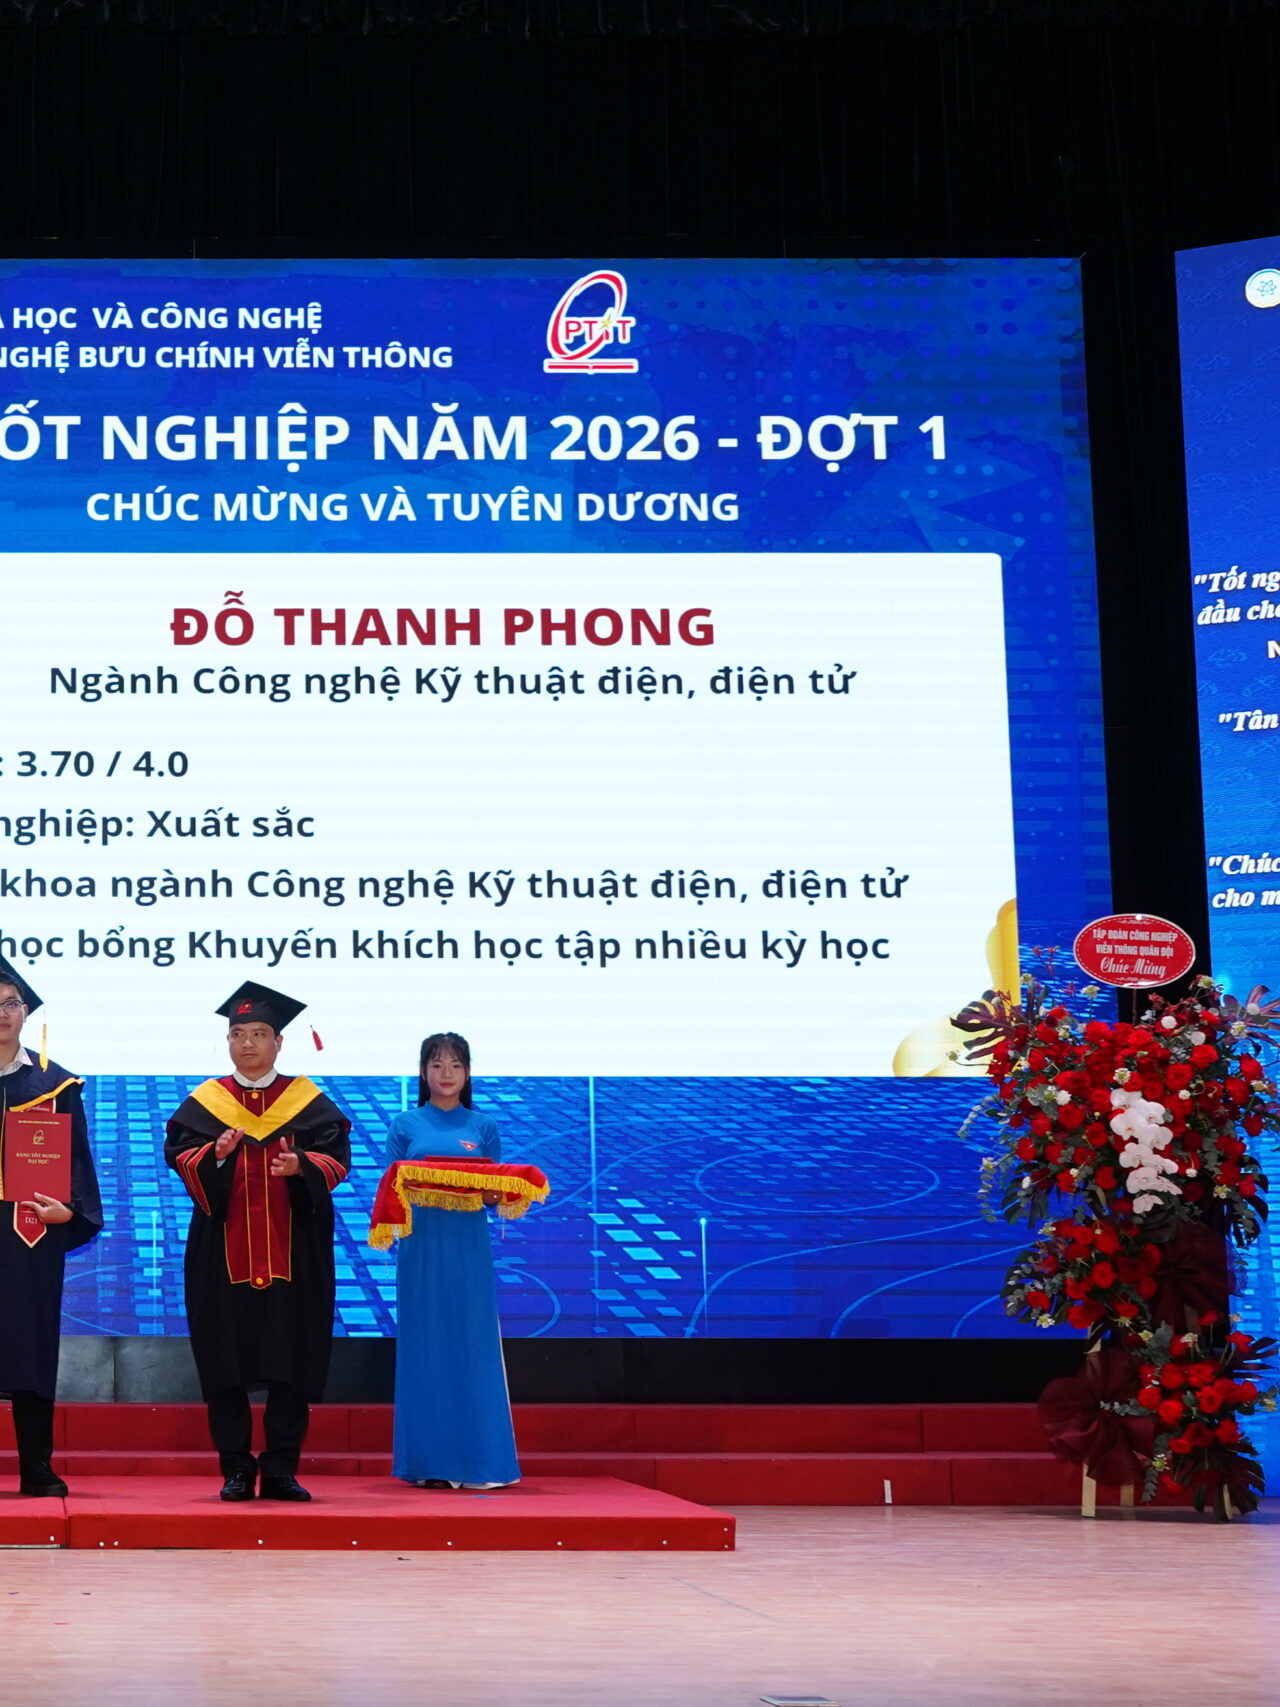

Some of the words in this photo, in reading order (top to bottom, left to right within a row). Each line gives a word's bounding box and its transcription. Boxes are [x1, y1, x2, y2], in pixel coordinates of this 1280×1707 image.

[13, 307, 77, 334] HỌC
[92, 301, 133, 329] VÀ
[141, 301, 228, 329] CÔNG
[238, 301, 322, 334] NGHỆ
[79, 345, 146, 368] BƯU
[155, 341, 254, 368] CHÍNH
[262, 337, 334, 368] VIỄN
[342, 341, 453, 368] THÔNG
[103, 402, 350, 473] NGHIỆP
[373, 402, 527, 461] NĂM
[550, 415, 700, 461] 2026
[718, 438, 738, 448] -
[756, 412, 899, 473] ĐỢT
[918, 415, 946, 460] 1
[86, 485, 200, 521] CHÚC
[214, 485, 348, 521] MỪNG
[360, 485, 417, 521] VÀ
[426, 485, 563, 521] TUYÊN
[578, 491, 739, 522] DƯƠNG
[1194, 565, 1247, 593] "Tốt
[169, 590, 255, 646] ĐỖ
[273, 608, 481, 646] THANH
[503, 607, 716, 647] PHONG
[1197, 598, 1241, 625] đầu
[50, 665, 178, 703] Ngành
[193, 665, 291, 703] Công
[305, 665, 401, 703] nghệ
[415, 666, 462, 703] Kỹ
[474, 665, 585, 702] thuật
[598, 666, 695, 702] điện,
[709, 665, 795, 702] điện
[808, 663, 858, 695] tử
[1218, 709, 1280, 732] "Tân
[17, 750, 95, 777] 3.70
[106, 750, 122, 777] /
[132, 751, 189, 778] 4.0
[147, 806, 240, 838] Xuất
[252, 806, 315, 838] sắc
[0, 868, 96, 898] khoa
[111, 868, 233, 907] ngành
[247, 869, 345, 907] Công
[359, 869, 454, 907] nghệ
[468, 869, 515, 907] Kỹ
[527, 869, 638, 906] thuật
[650, 869, 748, 906] điện,
[762, 869, 847, 906] điện
[860, 866, 910, 899] tử
[1212, 888, 1255, 908] cho
[78, 925, 175, 967] bổng
[188, 927, 337, 968] Khuyến
[352, 929, 459, 959] khích
[474, 930, 543, 967] học
[555, 930, 621, 968] tập
[635, 928, 747, 959] nhiều
[761, 930, 807, 968] kỳ
[820, 930, 890, 967] học
[1114, 943, 1138, 955] THÔNG
[1129, 929, 1150, 941] CÔNG
[1151, 930, 1178, 944] NGHIỆP
[1100, 956, 1130, 973] Chúc
[1131, 958, 1167, 979] Mừng
